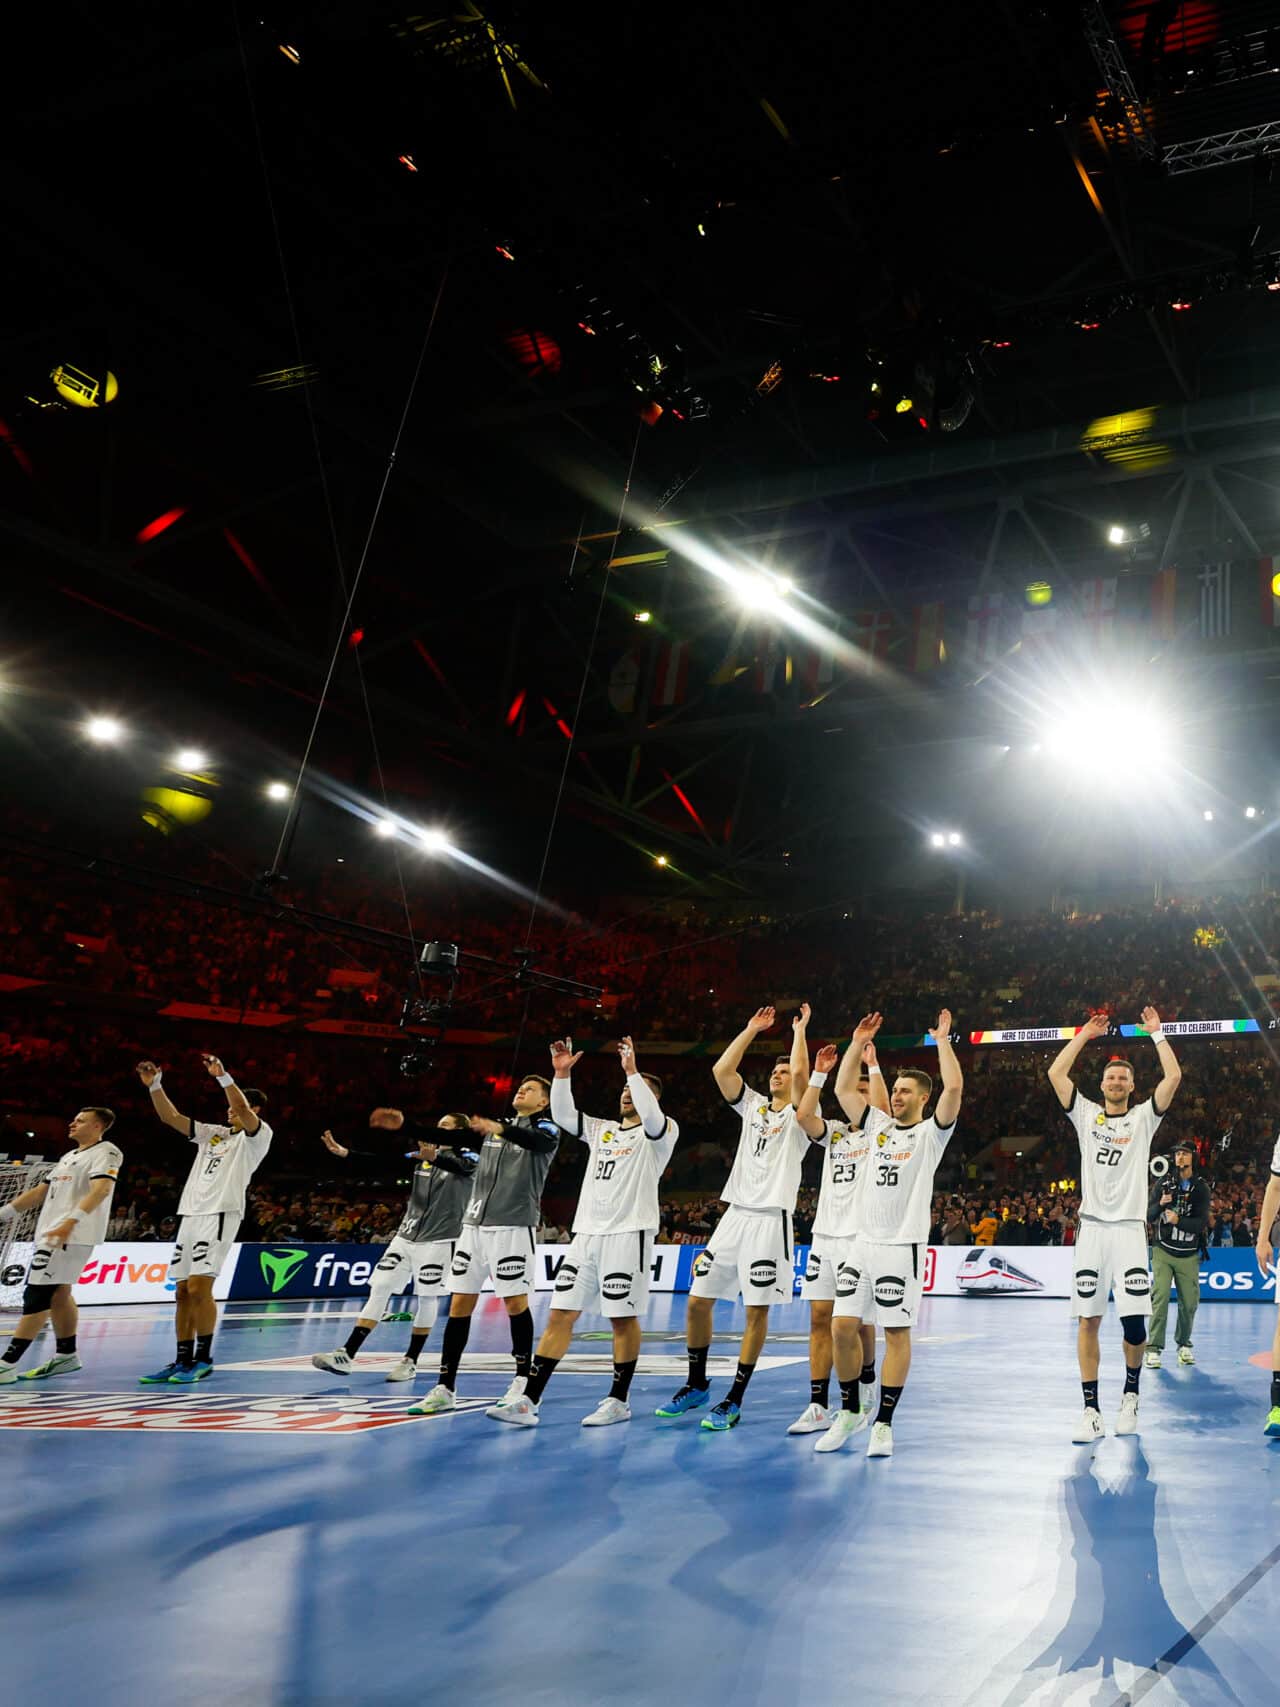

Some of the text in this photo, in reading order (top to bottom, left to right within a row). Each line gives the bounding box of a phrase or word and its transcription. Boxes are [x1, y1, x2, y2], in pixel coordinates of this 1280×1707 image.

[1162, 1021, 1223, 1033] HERE TO CELEBRATE
[1001, 1029, 1059, 1041] HERE TO CELEBRATE
[1096, 1147, 1123, 1166] 20
[832, 1163, 856, 1184] 23
[876, 1165, 899, 1186] 36
[875, 1287, 905, 1296] HARTING
